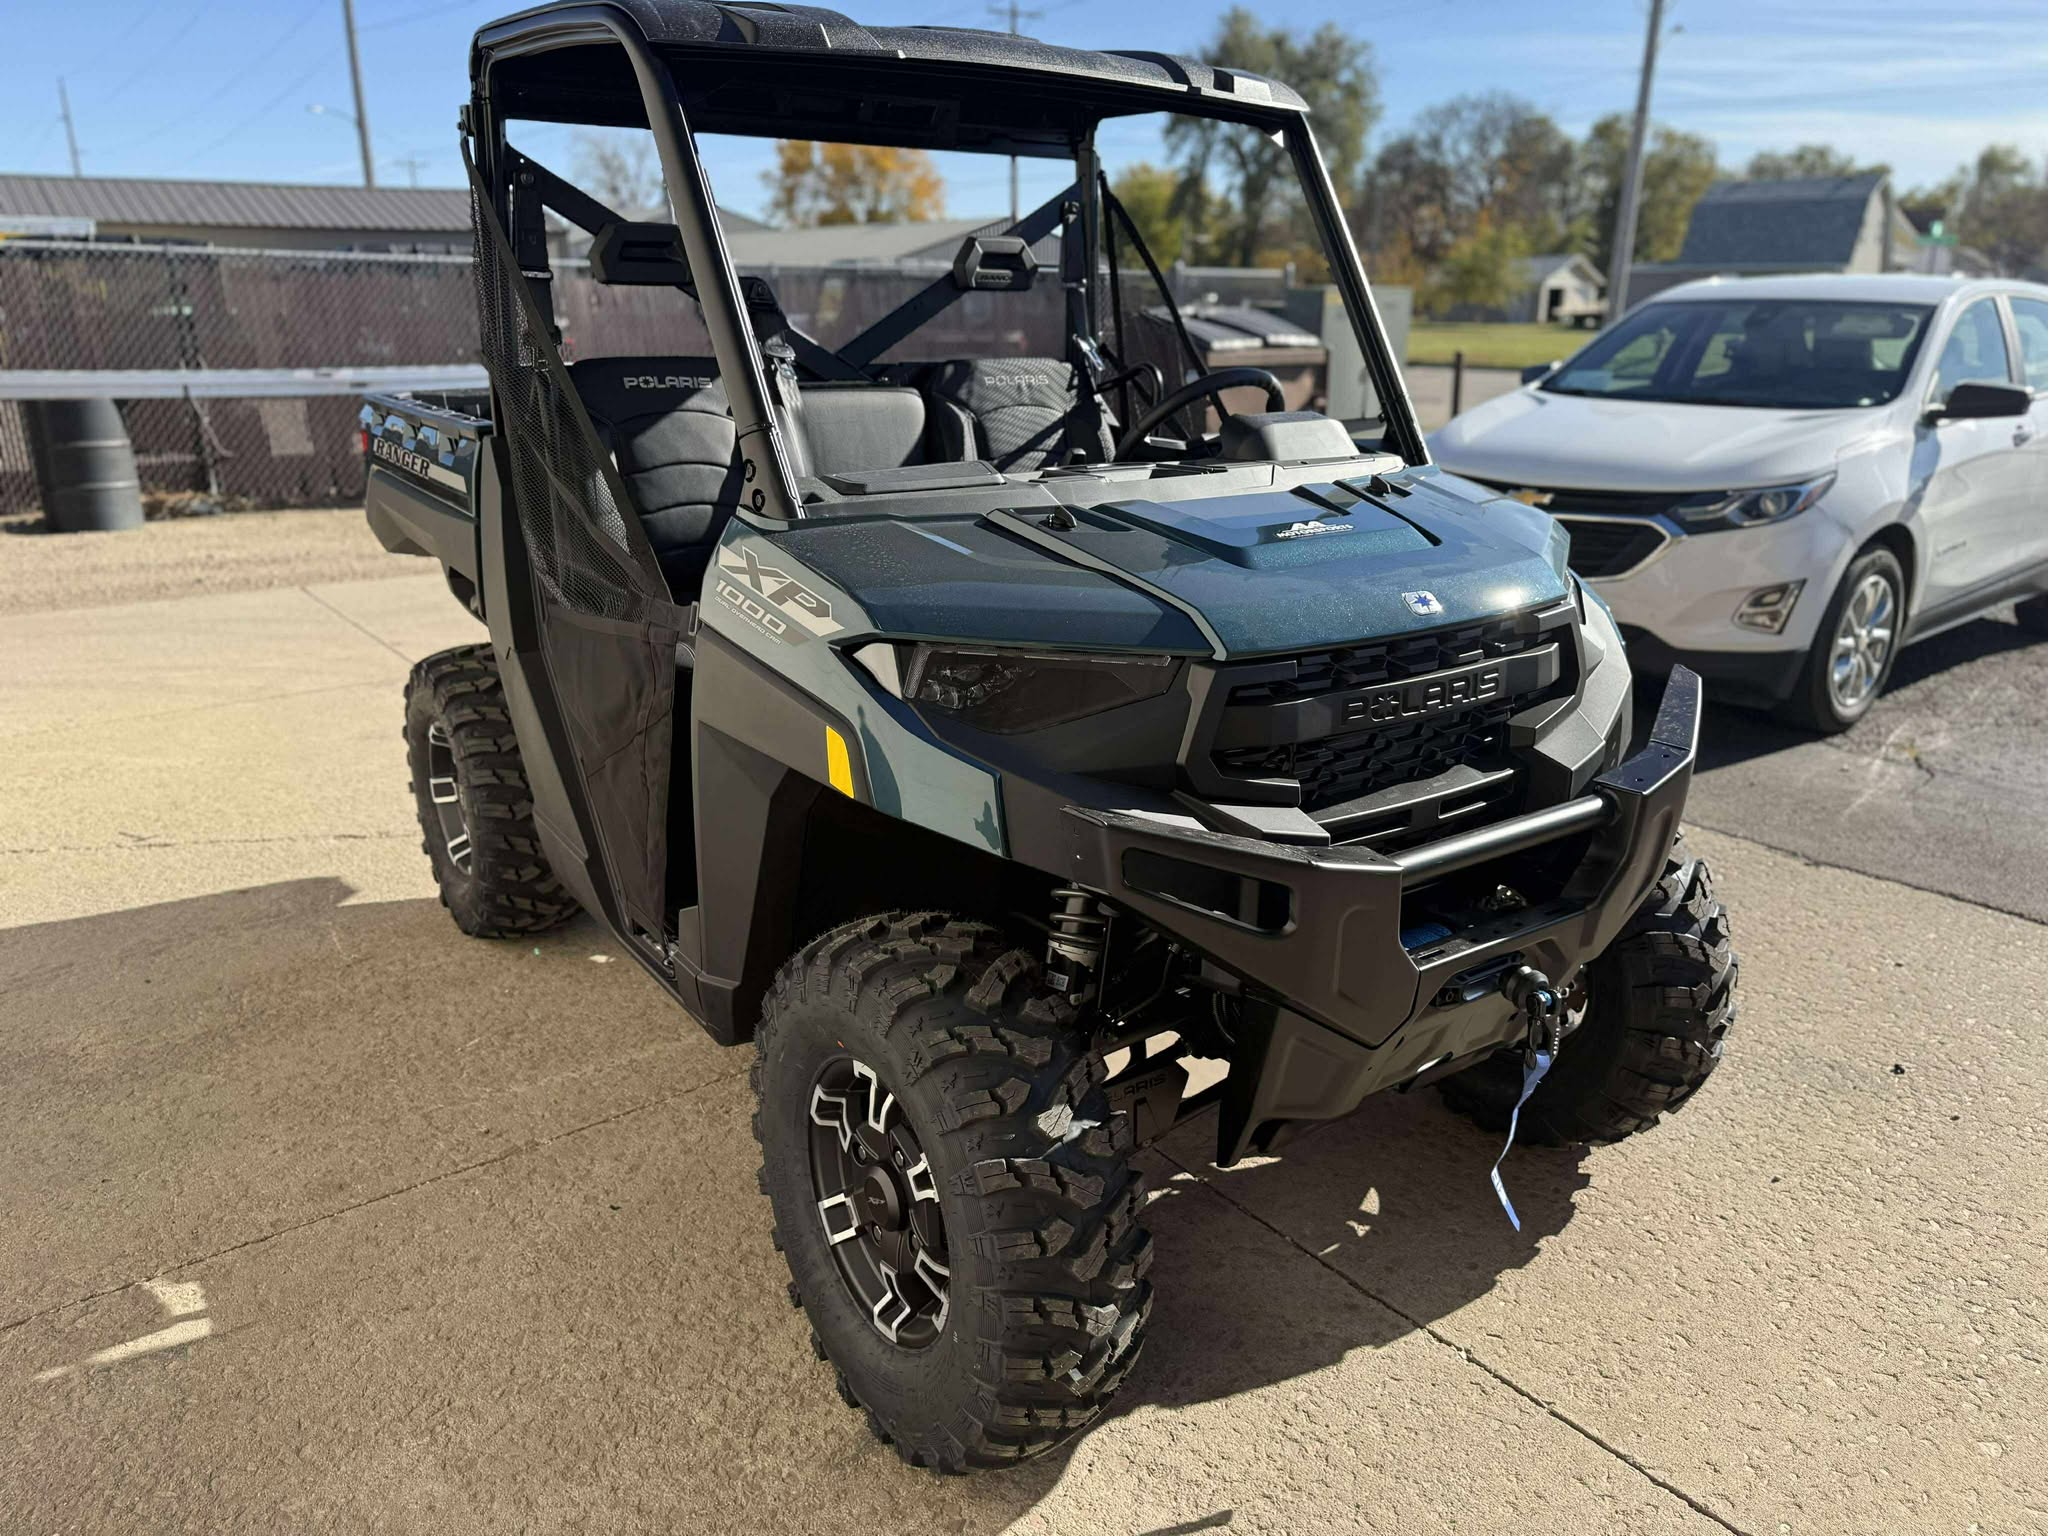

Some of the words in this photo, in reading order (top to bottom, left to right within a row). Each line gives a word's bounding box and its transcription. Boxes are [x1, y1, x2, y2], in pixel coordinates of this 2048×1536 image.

[623, 376, 713, 389] POLARIS
[983, 375, 1049, 386] POLARIS
[374, 438, 430, 479] RANGER
[715, 579, 787, 635] 1000
[719, 545, 832, 619] XP
[714, 595, 731, 610] DUAL
[731, 607, 766, 634] OVERHEAD
[765, 632, 781, 645] CAM
[1342, 667, 1499, 727] POLARIS
